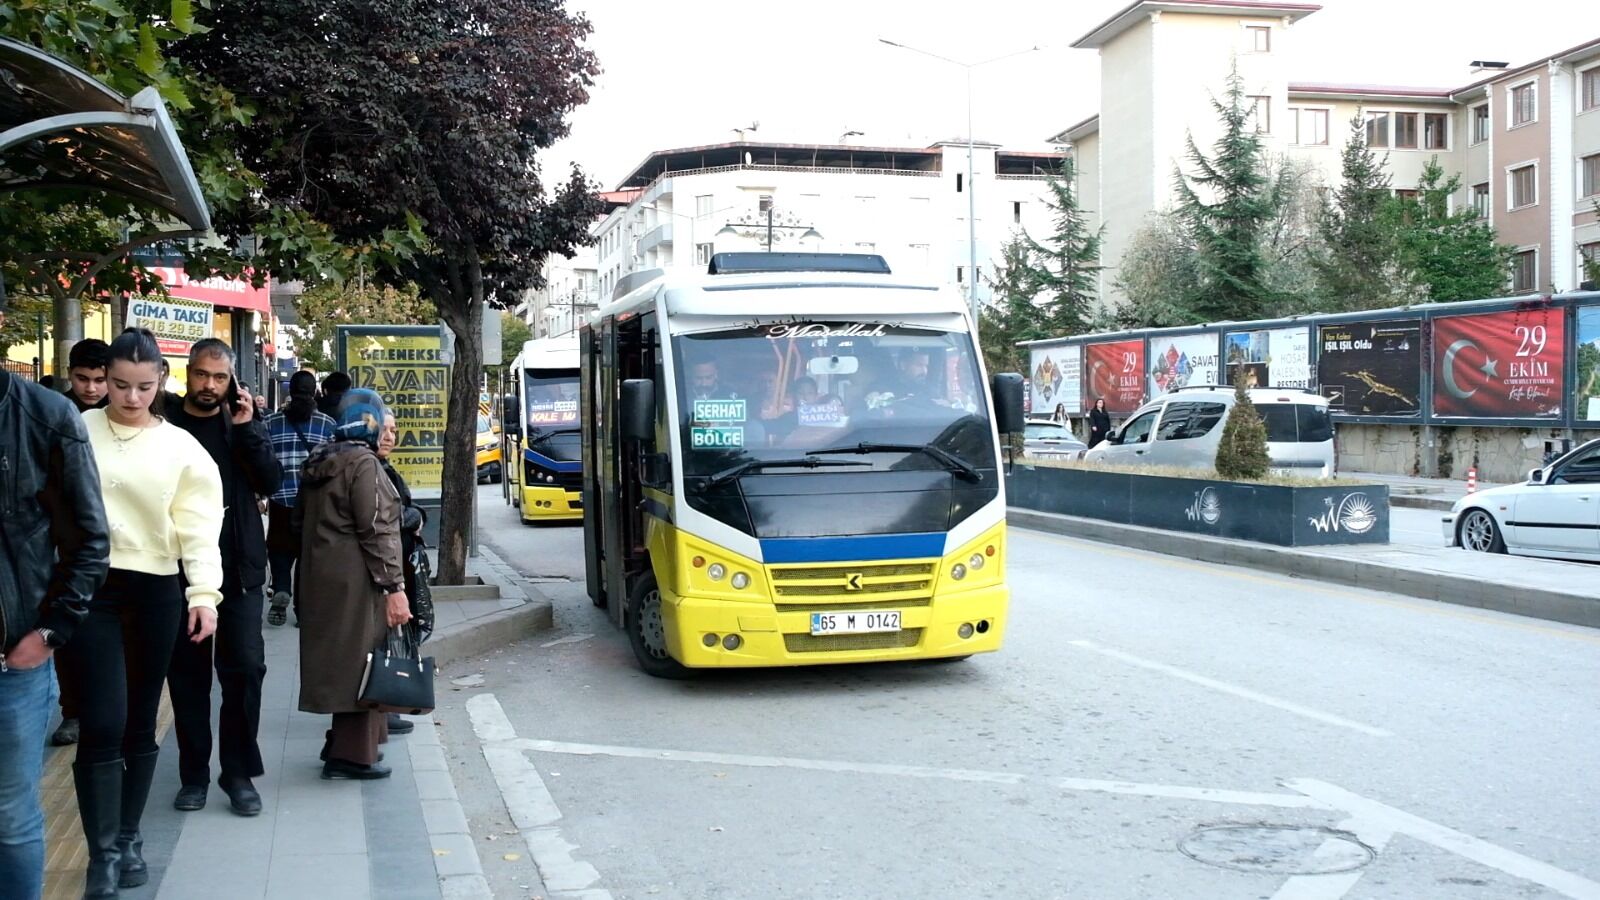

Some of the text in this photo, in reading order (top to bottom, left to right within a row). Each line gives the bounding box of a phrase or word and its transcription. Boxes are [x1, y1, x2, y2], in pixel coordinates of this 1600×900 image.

[132, 302, 209, 324] GİMA TAKSİ
[188, 325, 204, 336] 55
[1354, 339, 1372, 350] Oldu
[1515, 325, 1547, 357] 29
[1123, 351, 1137, 373] 29
[1191, 355, 1219, 367] SAVAT
[1510, 357, 1548, 377] EKİM
[1120, 373, 1138, 387] EKİM
[381, 391, 443, 405] ÖRESEL
[391, 406, 443, 418] ÜNLER
[531, 412, 559, 423] KALE
[697, 404, 743, 418] SERHAT
[694, 429, 741, 446] BÖLGE
[404, 456, 434, 465] KASIM
[820, 613, 898, 630] 65 M 0142
